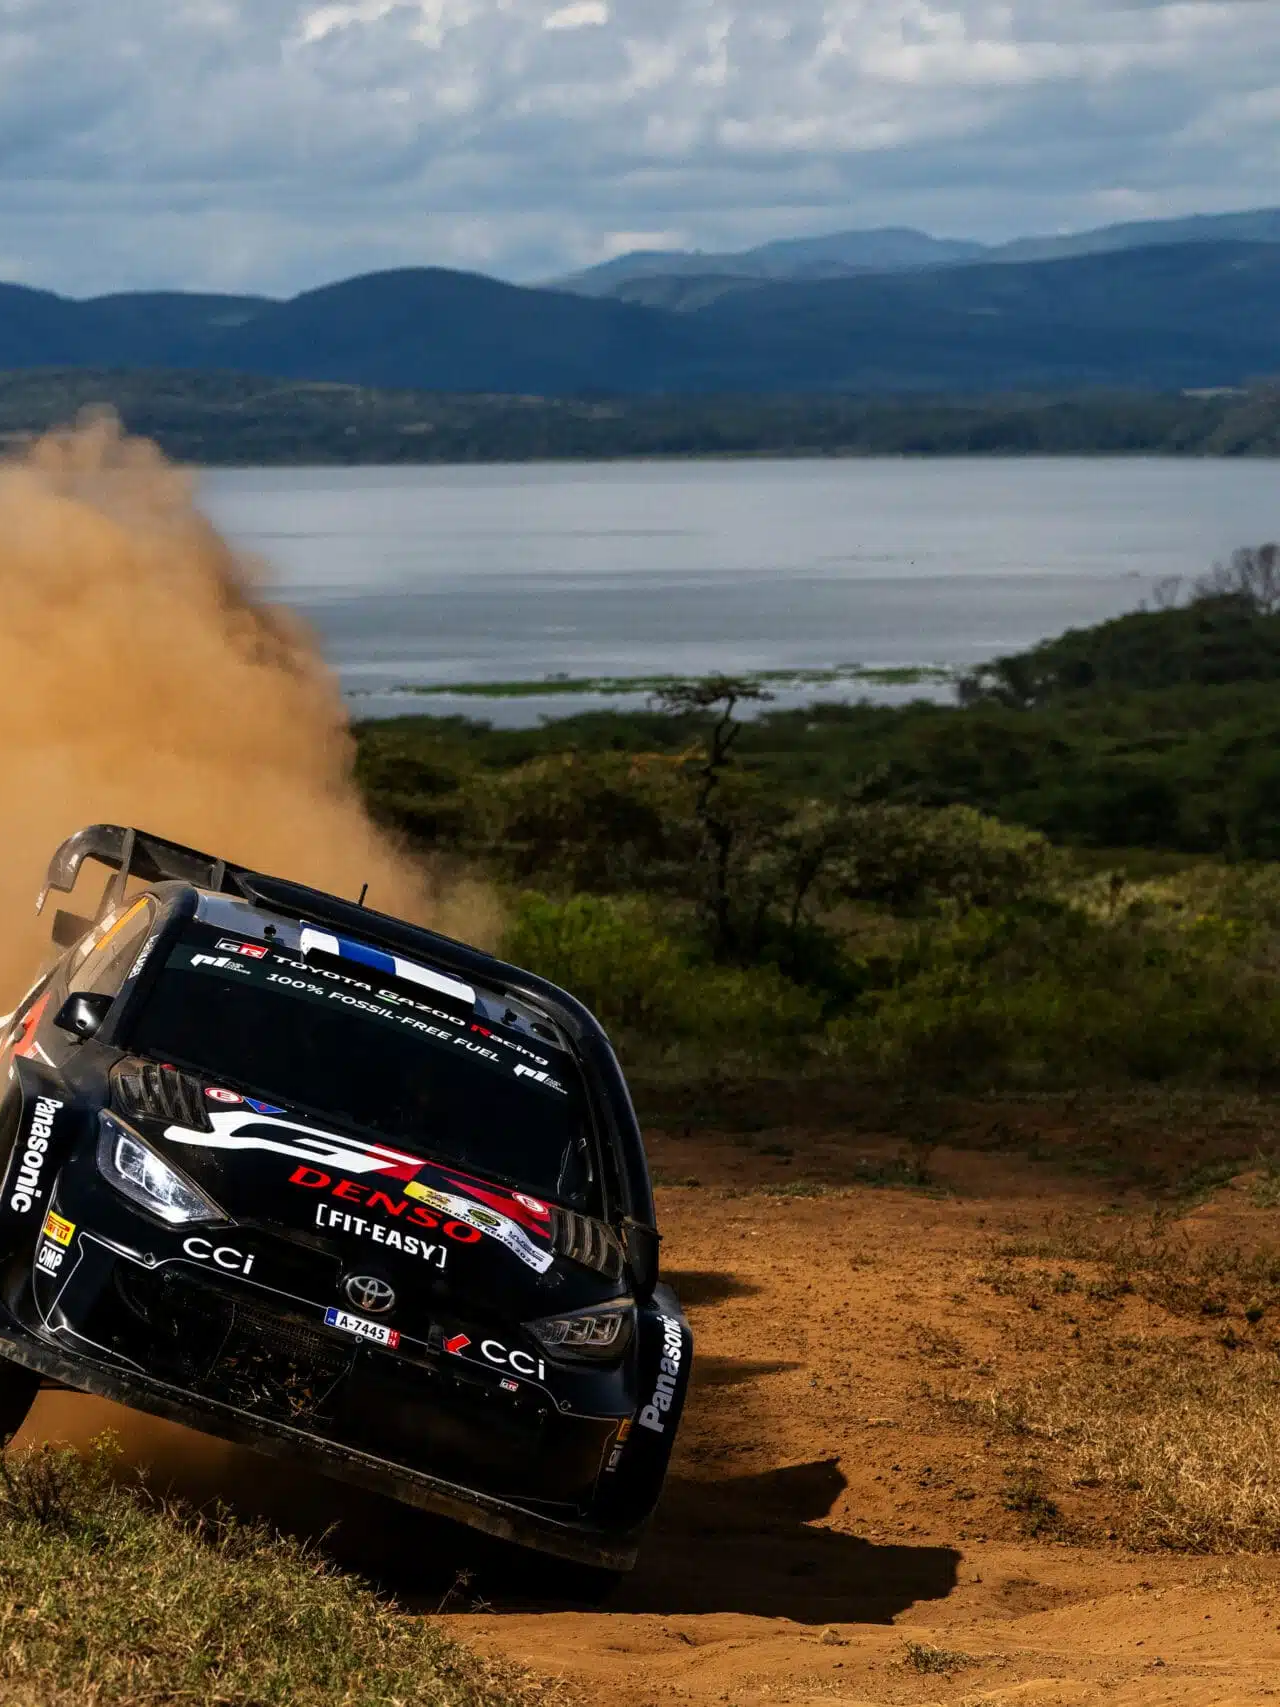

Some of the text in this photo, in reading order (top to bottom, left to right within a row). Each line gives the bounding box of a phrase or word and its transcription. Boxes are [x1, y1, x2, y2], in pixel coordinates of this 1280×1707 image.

[217, 940, 549, 1066] GR TOYOTA GAZOO Racing
[266, 973, 500, 1062] 100% FOSSIL-FREE FUEL
[10, 1095, 64, 1213] Panasonic
[288, 1165, 482, 1243] DENSO
[419, 1195, 452, 1213] SAFARI
[454, 1212, 482, 1230] RALLY
[483, 1226, 513, 1248] KENYA
[515, 1246, 537, 1267] 2024
[38, 1246, 63, 1271] OMP
[339, 1315, 387, 1341] A-7445
[638, 1314, 683, 1433] Panasonic
